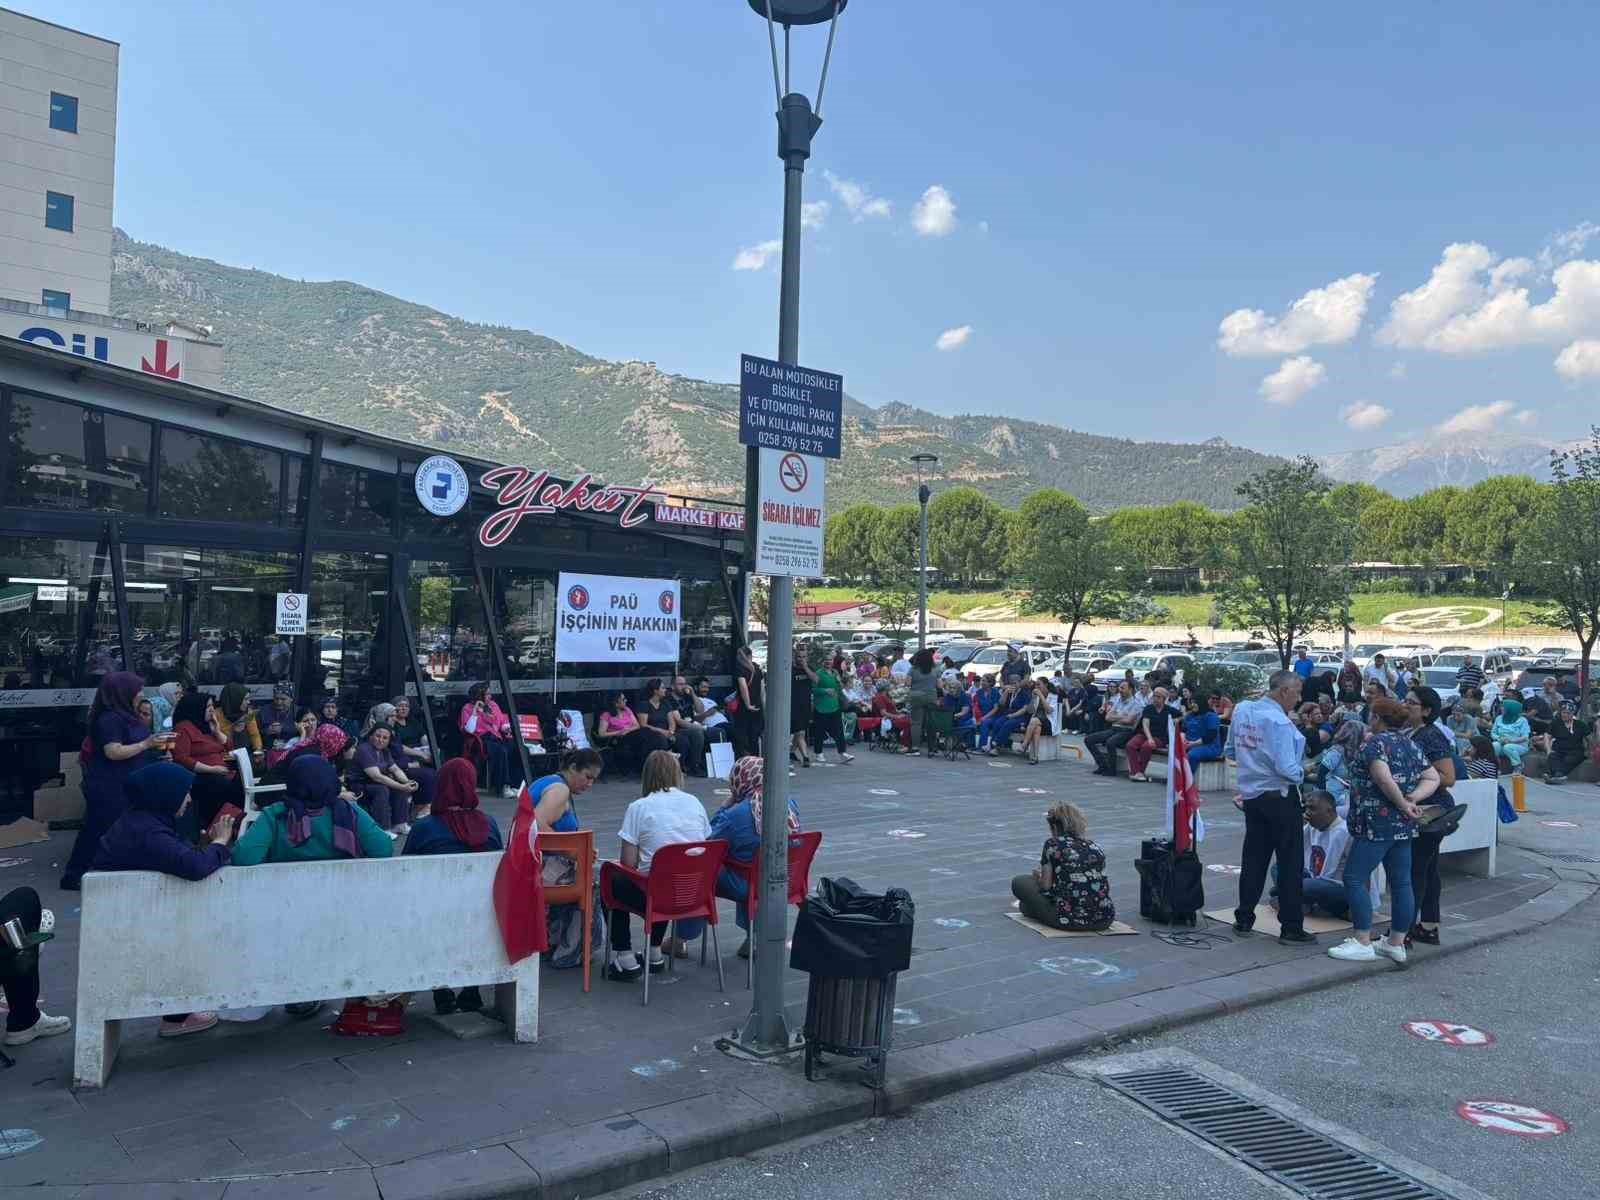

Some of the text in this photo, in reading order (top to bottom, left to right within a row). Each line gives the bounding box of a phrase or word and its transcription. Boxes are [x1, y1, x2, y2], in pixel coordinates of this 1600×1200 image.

[744, 361, 839, 392] BU ALAN MOTOSİKLET
[772, 382, 813, 404] BİSİKLET,
[748, 395, 834, 422] VE OTOMOBİL PARKI
[747, 411, 835, 439] İÇİN KULLANILAMAZ
[758, 432, 780, 446] 0258
[782, 435, 798, 450] 296
[800, 439, 811, 451] 52
[480, 465, 671, 547] Yakut
[657, 506, 714, 525] MARKET
[763, 498, 821, 528] SİGARA İÇİLMEZ
[610, 592, 638, 610] PAÜ
[560, 610, 618, 633] İŞÇİNİN
[608, 637, 636, 651] VER
